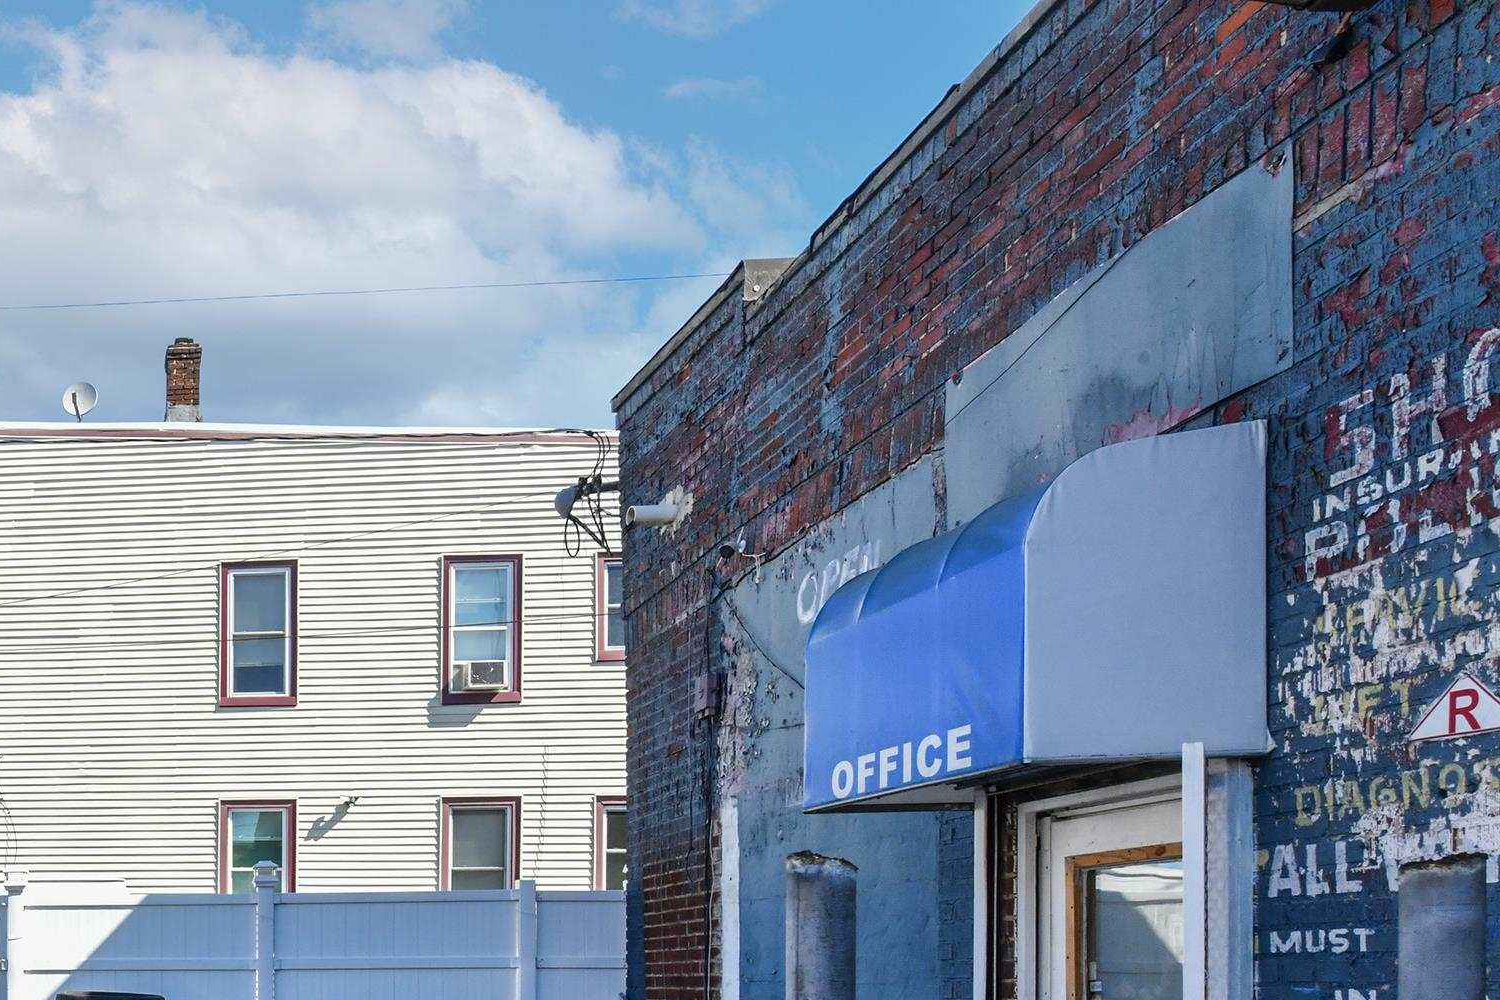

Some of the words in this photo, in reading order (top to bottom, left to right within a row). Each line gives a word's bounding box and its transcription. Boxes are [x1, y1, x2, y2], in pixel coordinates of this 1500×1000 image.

[1449, 687, 1481, 736] R
[831, 724, 973, 800] OFFICE
[1267, 840, 1363, 898] ALL
[1269, 927, 1375, 954] MUST
